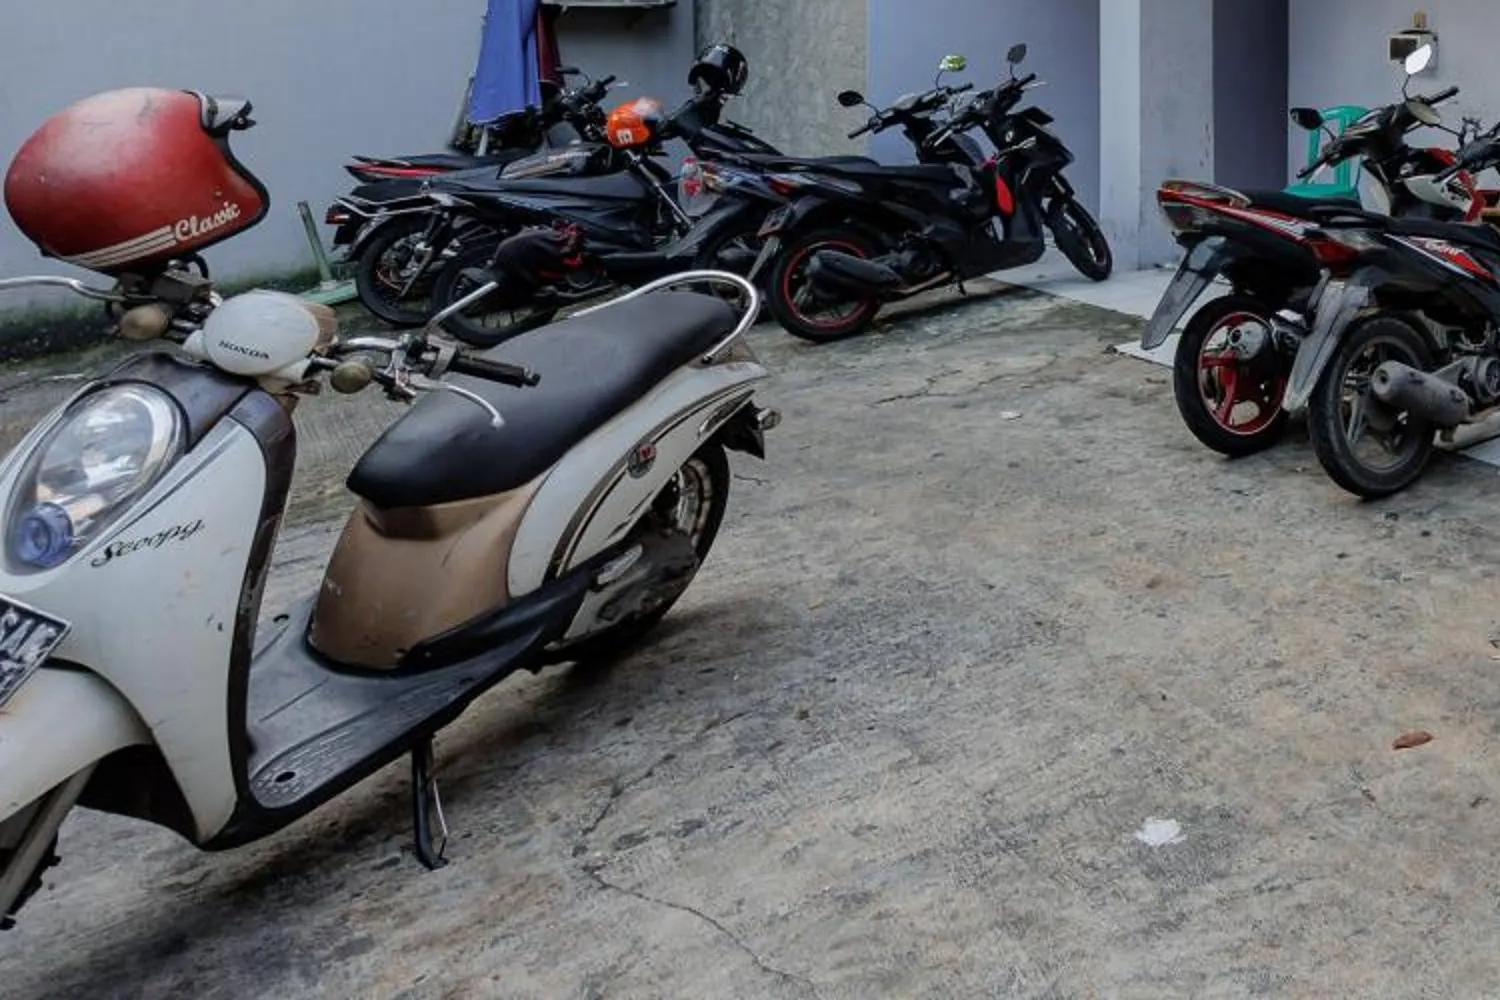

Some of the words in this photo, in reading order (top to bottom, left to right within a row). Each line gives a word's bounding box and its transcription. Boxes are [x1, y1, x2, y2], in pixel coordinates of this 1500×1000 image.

[175, 201, 240, 241] Classic
[219, 340, 269, 359] HONDA
[91, 519, 205, 567] Scoopy
